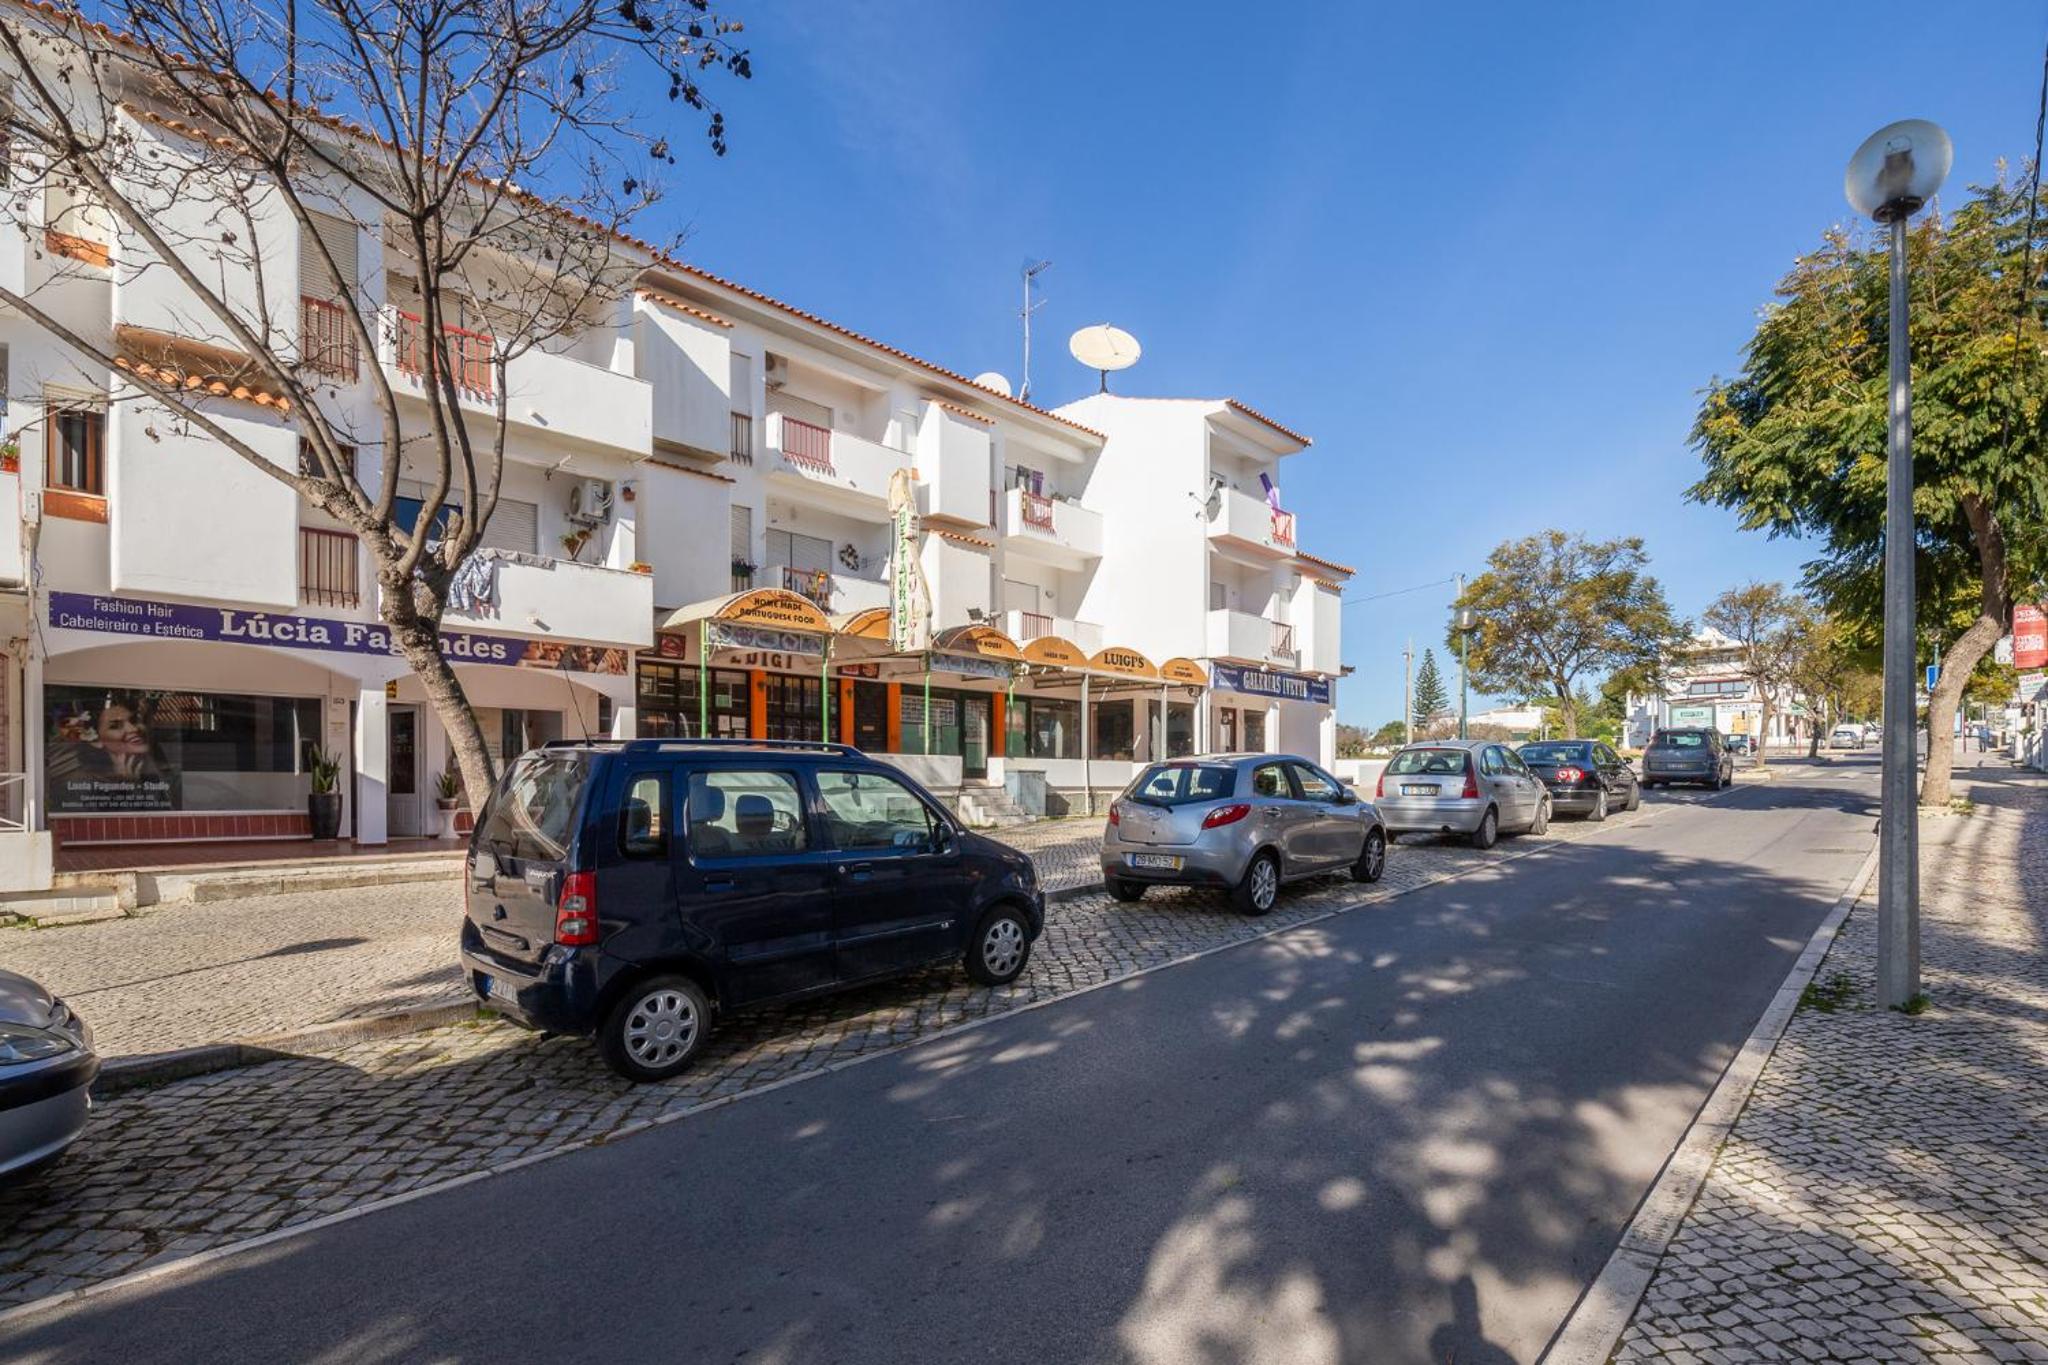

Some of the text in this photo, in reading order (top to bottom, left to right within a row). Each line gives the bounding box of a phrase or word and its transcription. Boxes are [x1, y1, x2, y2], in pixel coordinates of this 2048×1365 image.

[93, 598, 173, 618] Fashion Hair
[754, 598, 802, 611] HOME MADE
[740, 608, 816, 624] PORTUGUESE FOOD
[60, 613, 204, 638] Cabeleireiro e Estética
[219, 610, 507, 659] Lúcia Fagndes
[1104, 652, 1145, 669] LUIGI'S
